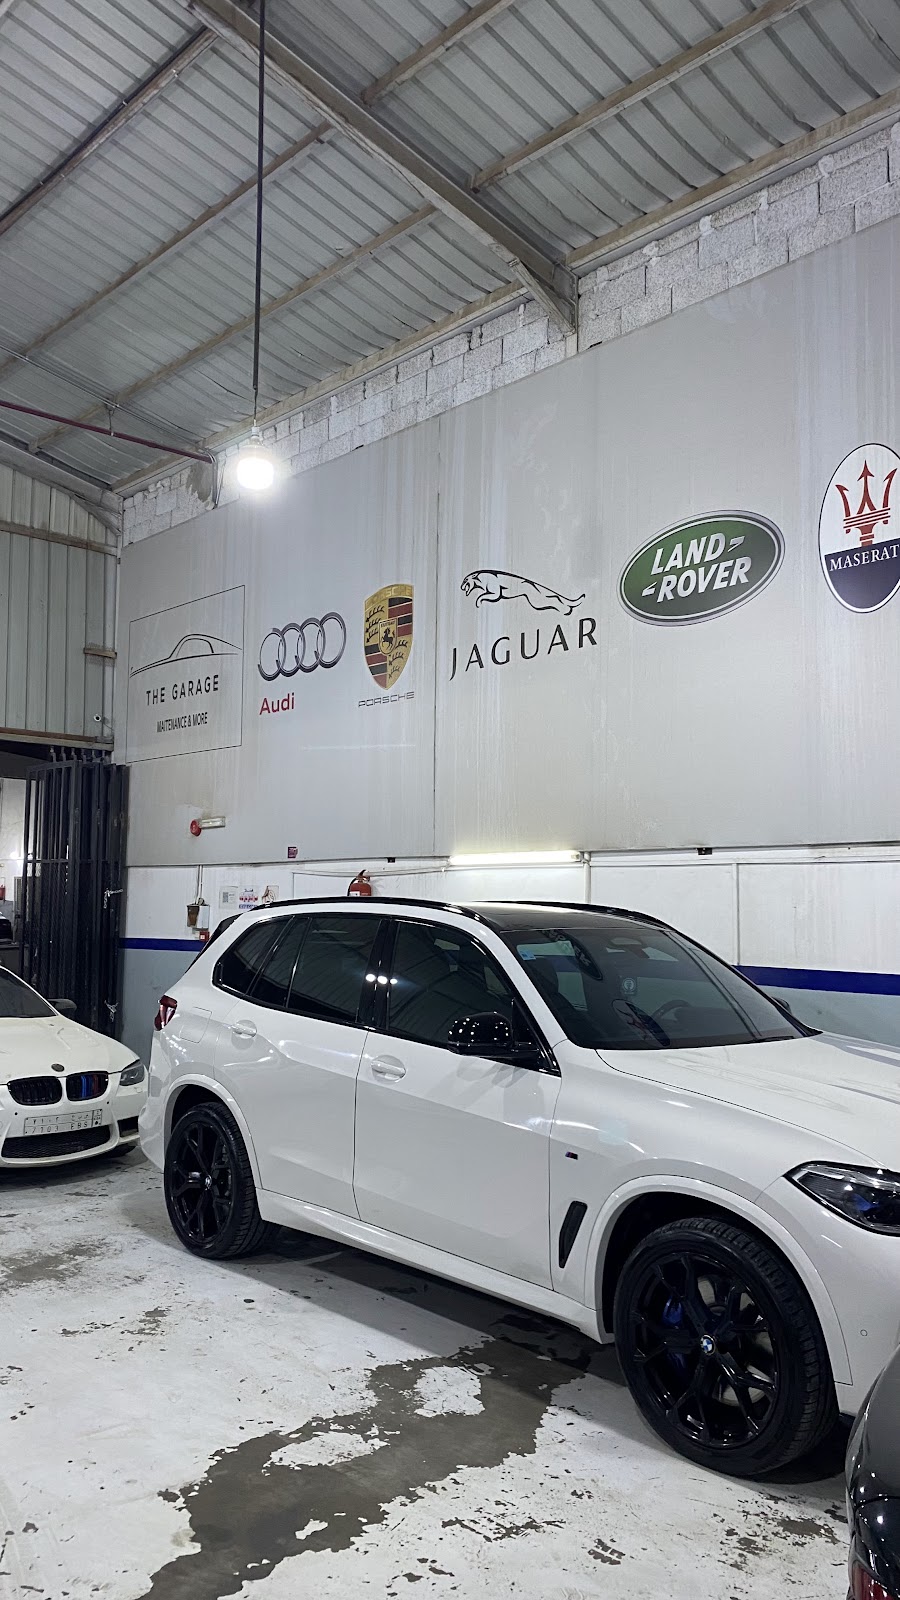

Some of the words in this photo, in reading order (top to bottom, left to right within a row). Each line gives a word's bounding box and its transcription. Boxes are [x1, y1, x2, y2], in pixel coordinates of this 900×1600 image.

[651, 533, 726, 576] LAND
[829, 544, 900, 571] MASERAT
[656, 556, 752, 603] ROVER
[449, 617, 598, 681] JAGUAR
[146, 687, 165, 706] THE
[172, 675, 219, 700] GARAGE
[259, 692, 295, 715] Audi
[358, 691, 415, 708] PORSCHE
[157, 716, 187, 733] MAITENANCE
[188, 715, 192, 727] &
[193, 712, 208, 726] MORE
